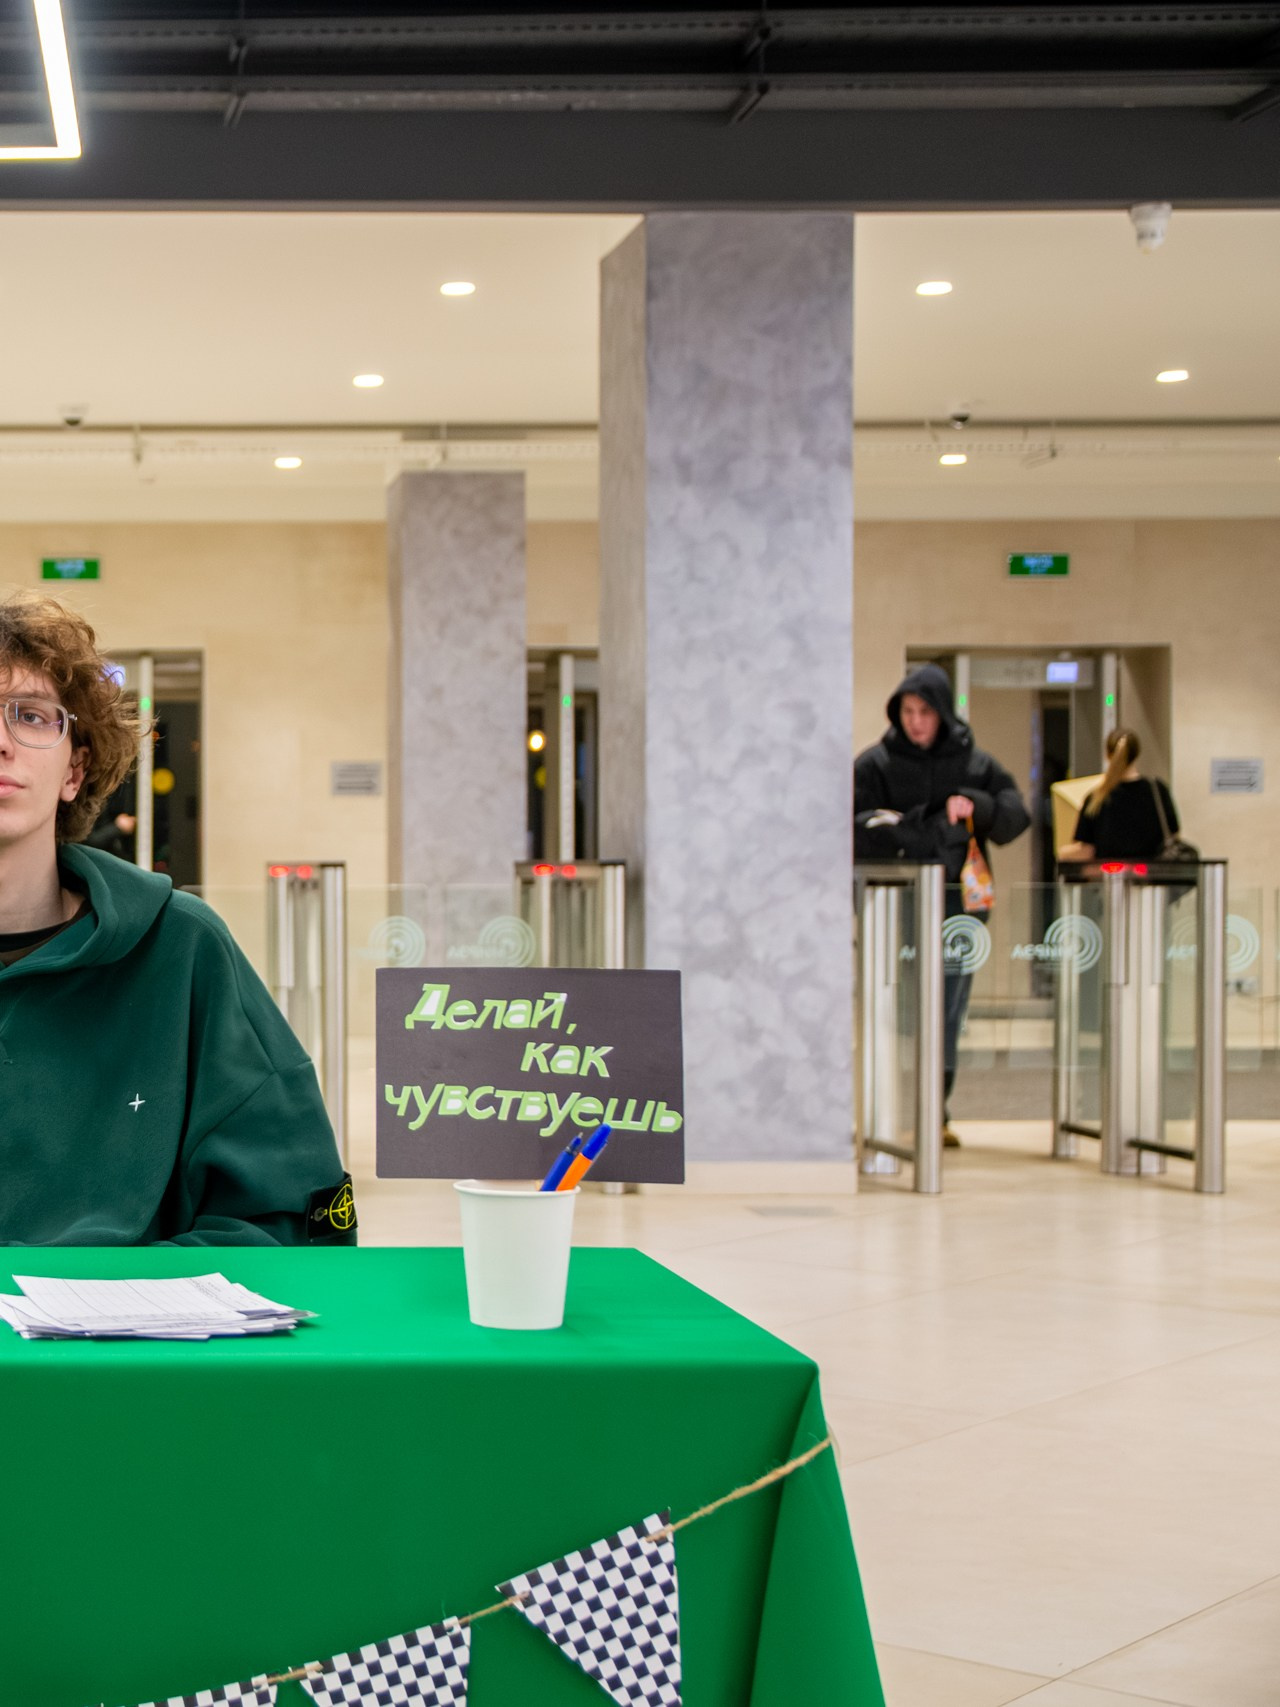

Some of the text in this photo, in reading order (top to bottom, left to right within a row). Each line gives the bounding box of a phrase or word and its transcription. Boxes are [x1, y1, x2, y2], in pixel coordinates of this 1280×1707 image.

[405, 983, 577, 1035] Делай,
[520, 1041, 614, 1078] как
[384, 1083, 683, 1137] чувствуешь
